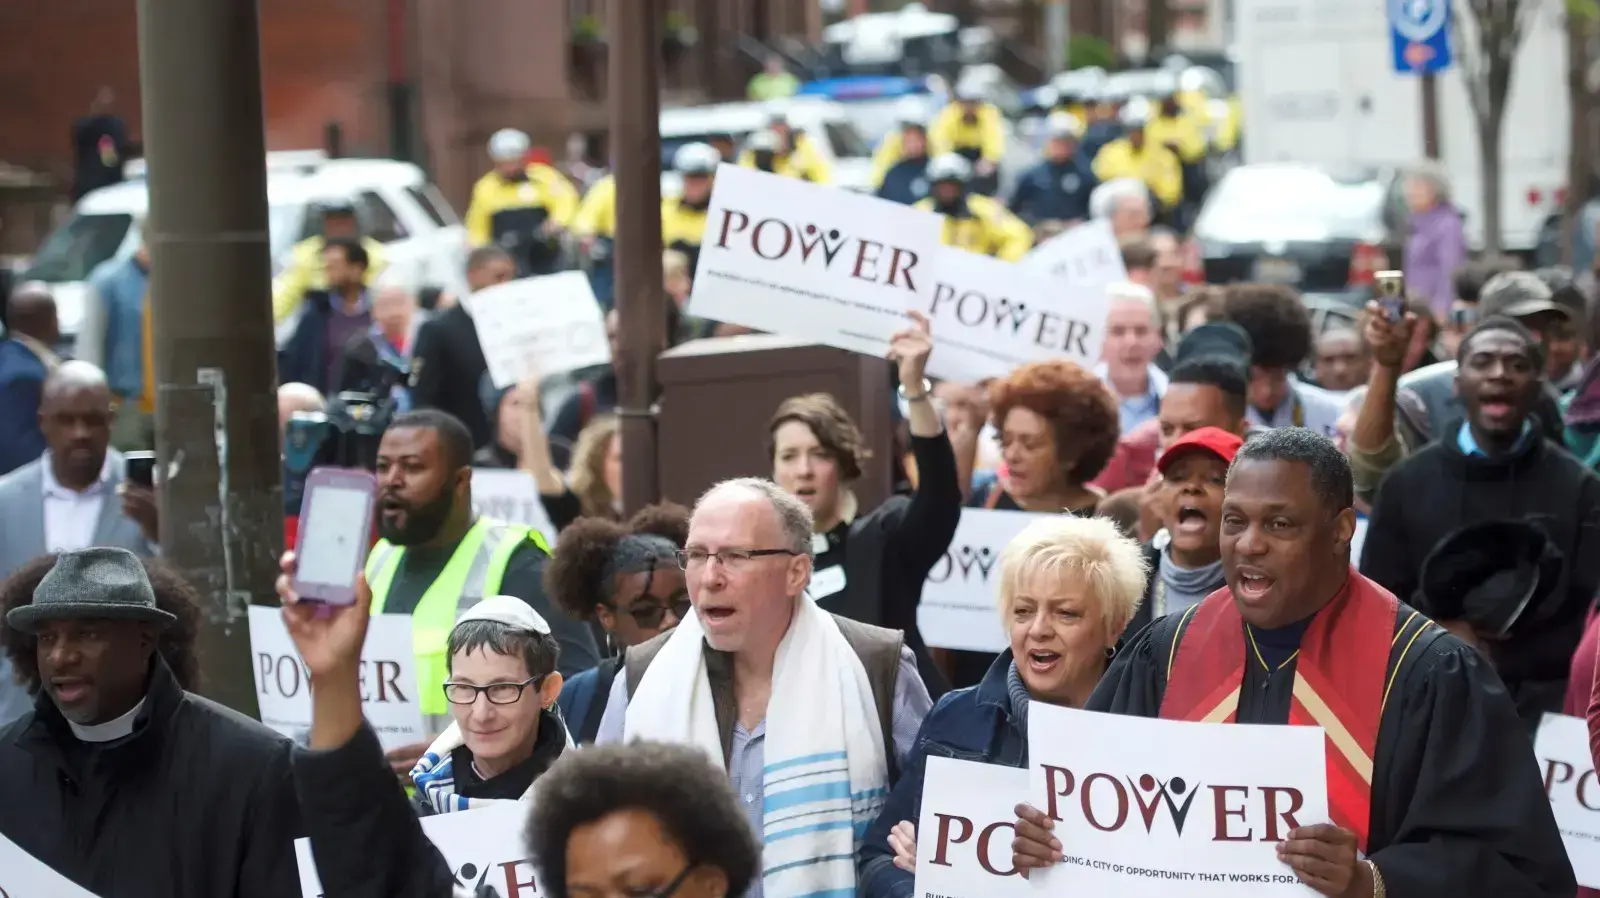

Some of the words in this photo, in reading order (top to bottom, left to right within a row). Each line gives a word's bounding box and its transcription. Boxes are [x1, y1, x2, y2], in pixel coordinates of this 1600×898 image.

[715, 208, 920, 292] POWER
[928, 281, 1092, 358] POWER
[1040, 763, 1305, 842] POWER
[1085, 859, 1092, 868] A
[1093, 860, 1112, 871] CITY
[1112, 864, 1125, 873] OF
[1126, 866, 1196, 881] OPPORTUNITY
[1198, 873, 1226, 882] THAT
[1228, 874, 1271, 883] WORKS
[1272, 875, 1294, 884] FOR
